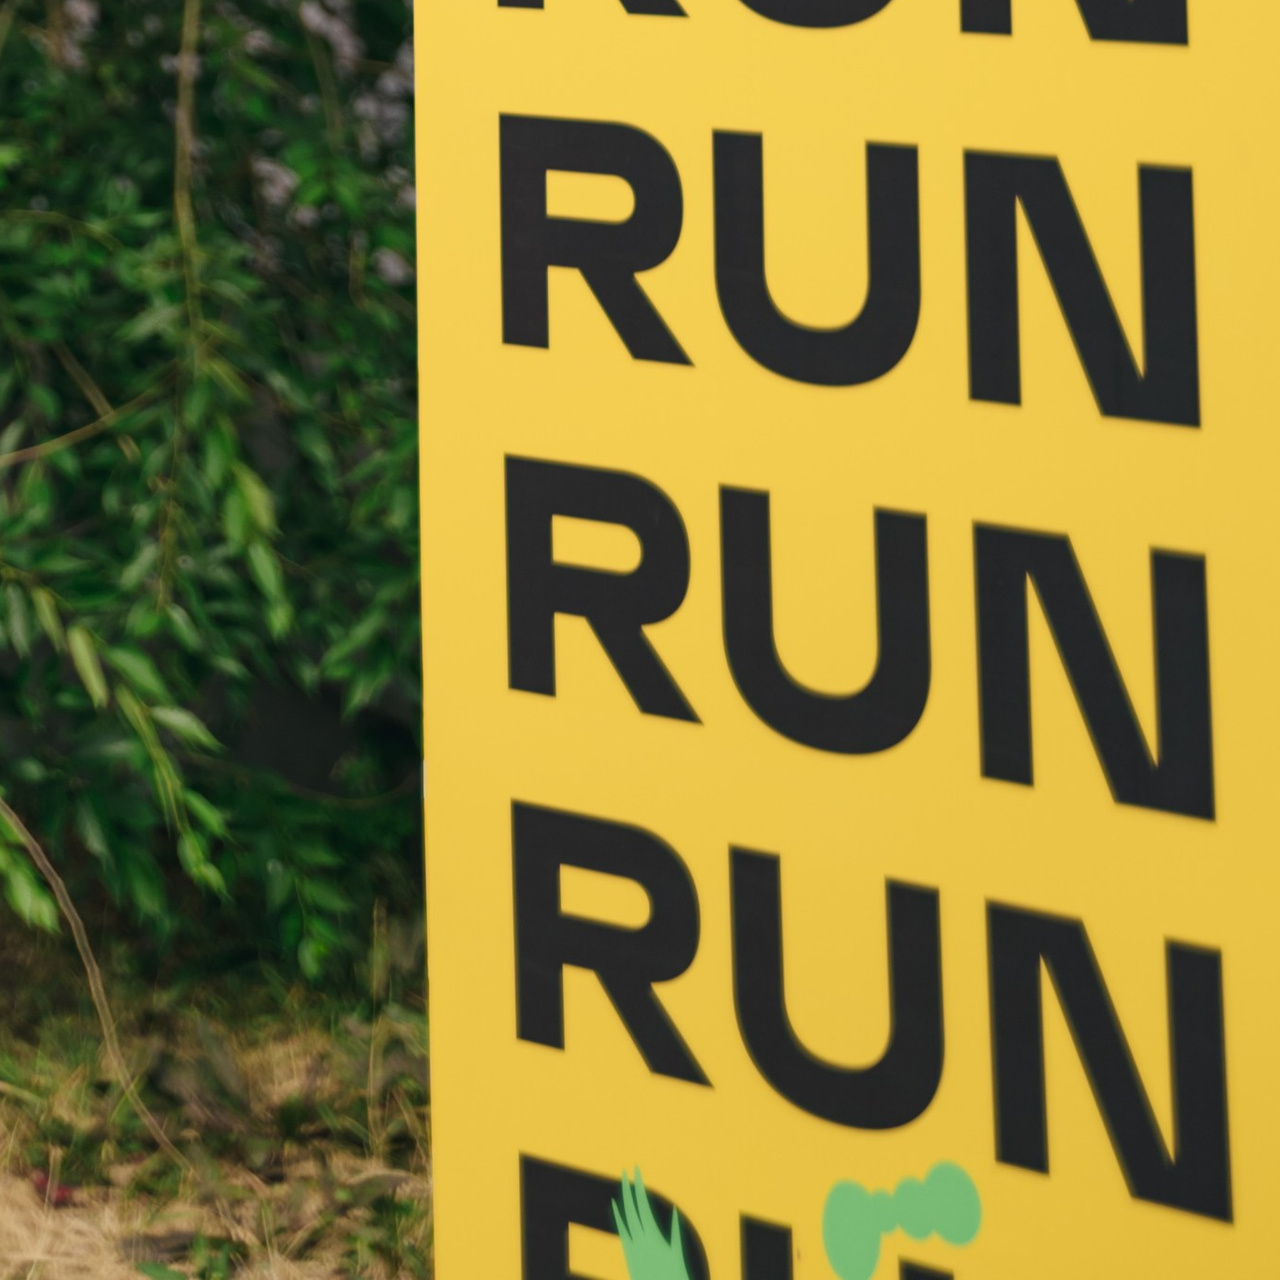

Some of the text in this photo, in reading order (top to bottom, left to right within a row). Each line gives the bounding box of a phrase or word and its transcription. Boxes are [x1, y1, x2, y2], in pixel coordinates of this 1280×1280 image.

[499, 113, 1201, 428] RUN
[504, 454, 1216, 822] RUN
[511, 800, 1234, 1224] RUN
